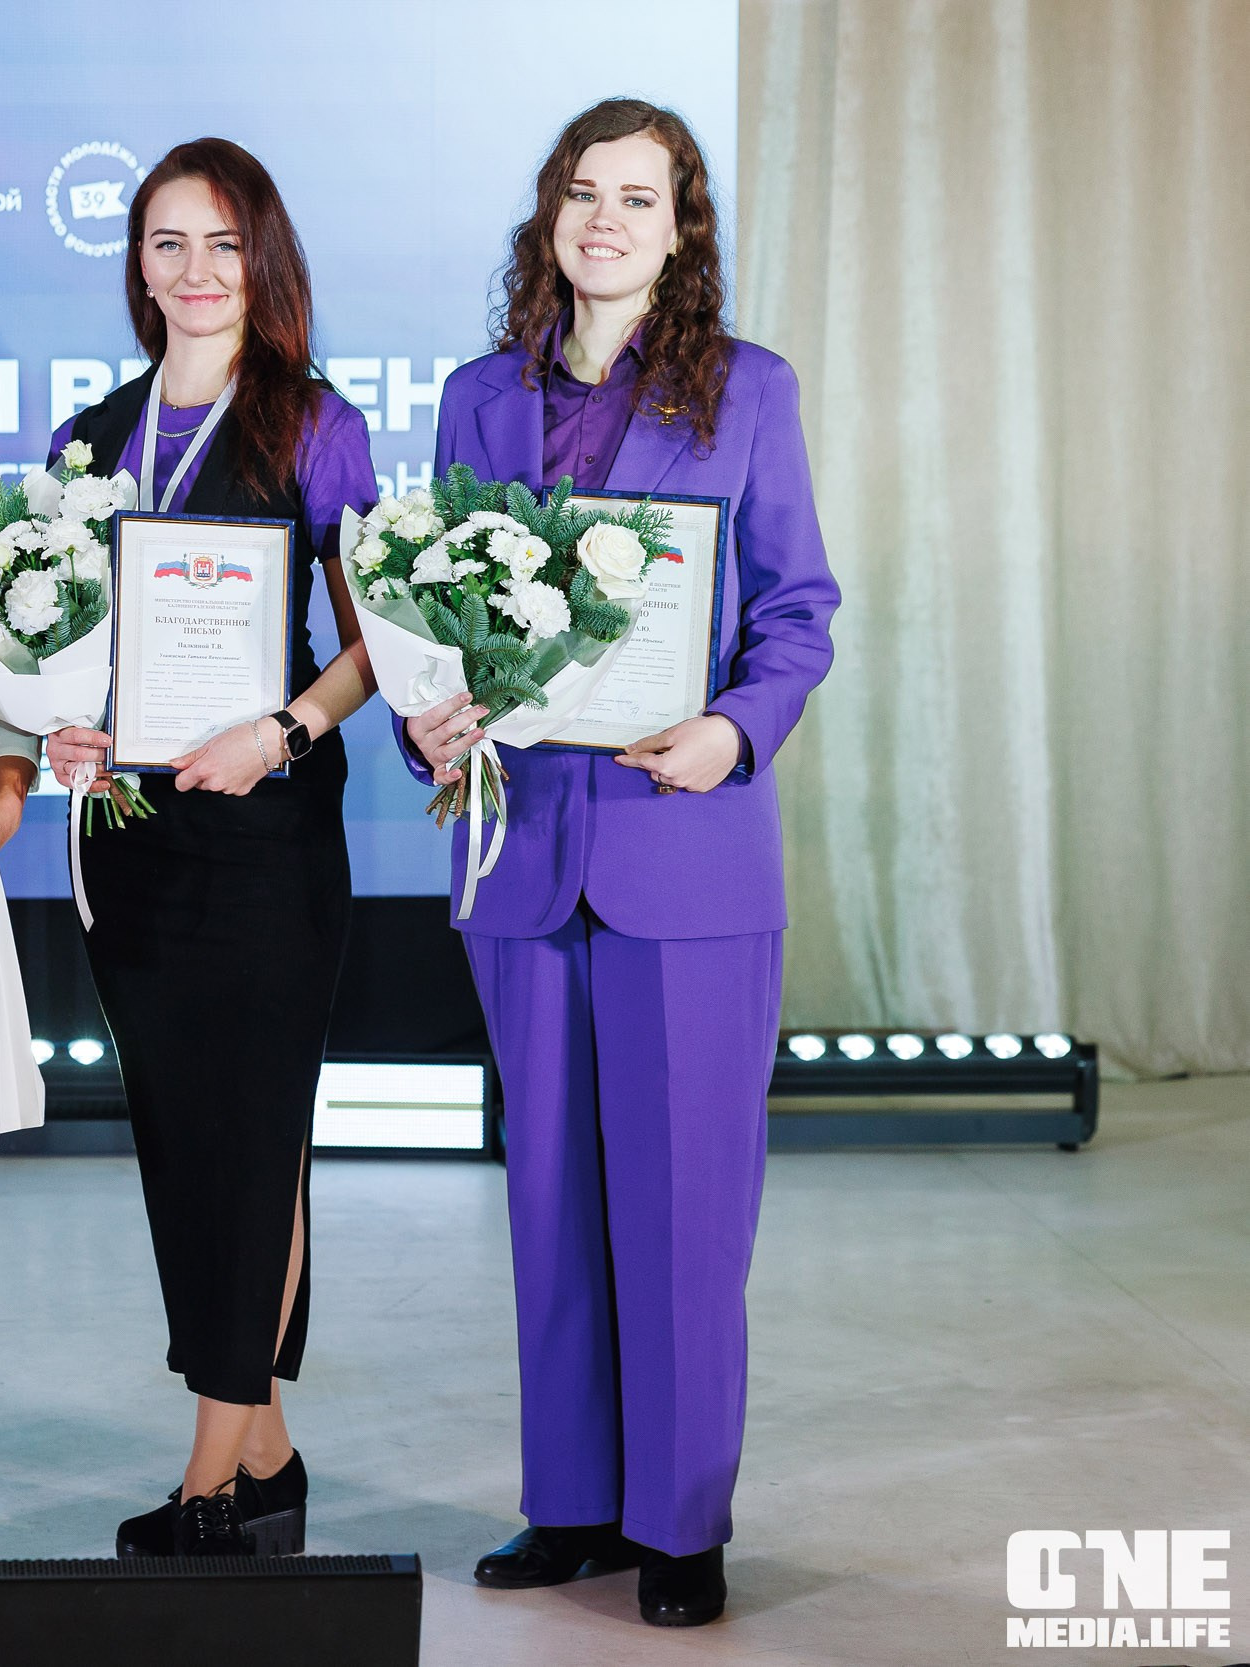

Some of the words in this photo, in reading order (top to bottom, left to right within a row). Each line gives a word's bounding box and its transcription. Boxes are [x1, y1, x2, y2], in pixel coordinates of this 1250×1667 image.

[81, 191, 105, 209] 39
[155, 616, 251, 627] БЛАГОДАРСТВЕННОЕ
[183, 627, 222, 636] ПИСЬМО
